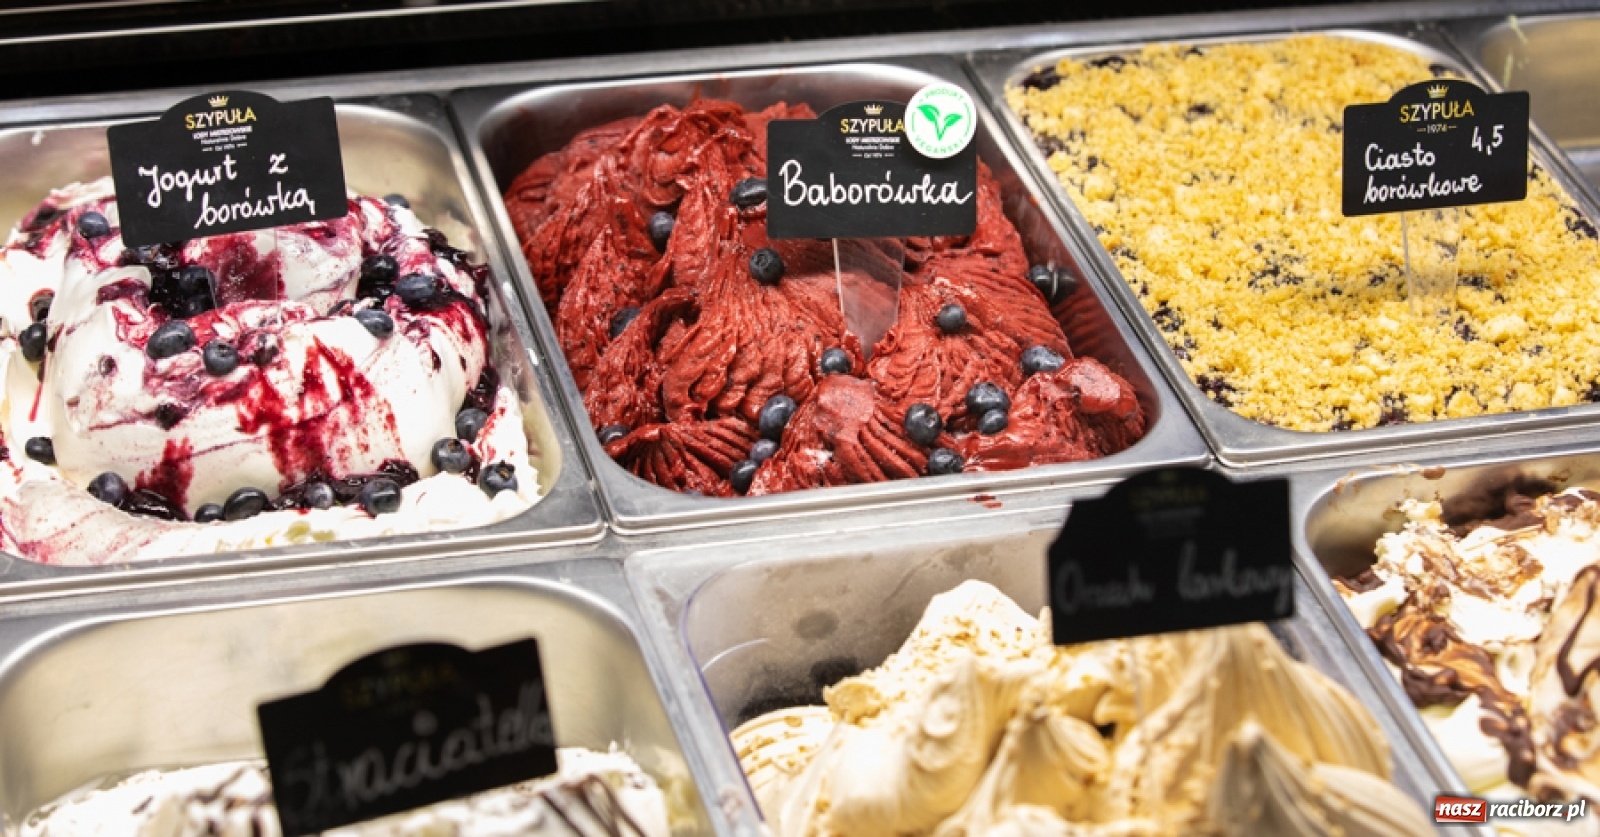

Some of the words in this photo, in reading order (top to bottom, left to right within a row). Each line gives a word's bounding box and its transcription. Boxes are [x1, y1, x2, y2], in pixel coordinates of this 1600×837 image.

[184, 106, 257, 130] SZYPUŁA
[840, 118, 906, 134] SZYPUŁA
[1399, 99, 1474, 123] SZYPUŁA
[1471, 124, 1505, 156] 4,5
[1364, 141, 1436, 172] Ciasto
[138, 153, 238, 208] Jogurt
[268, 152, 289, 175] z
[778, 159, 974, 207] Baborówka
[1362, 171, 1484, 204] borówkowe
[193, 180, 316, 230] borówką
